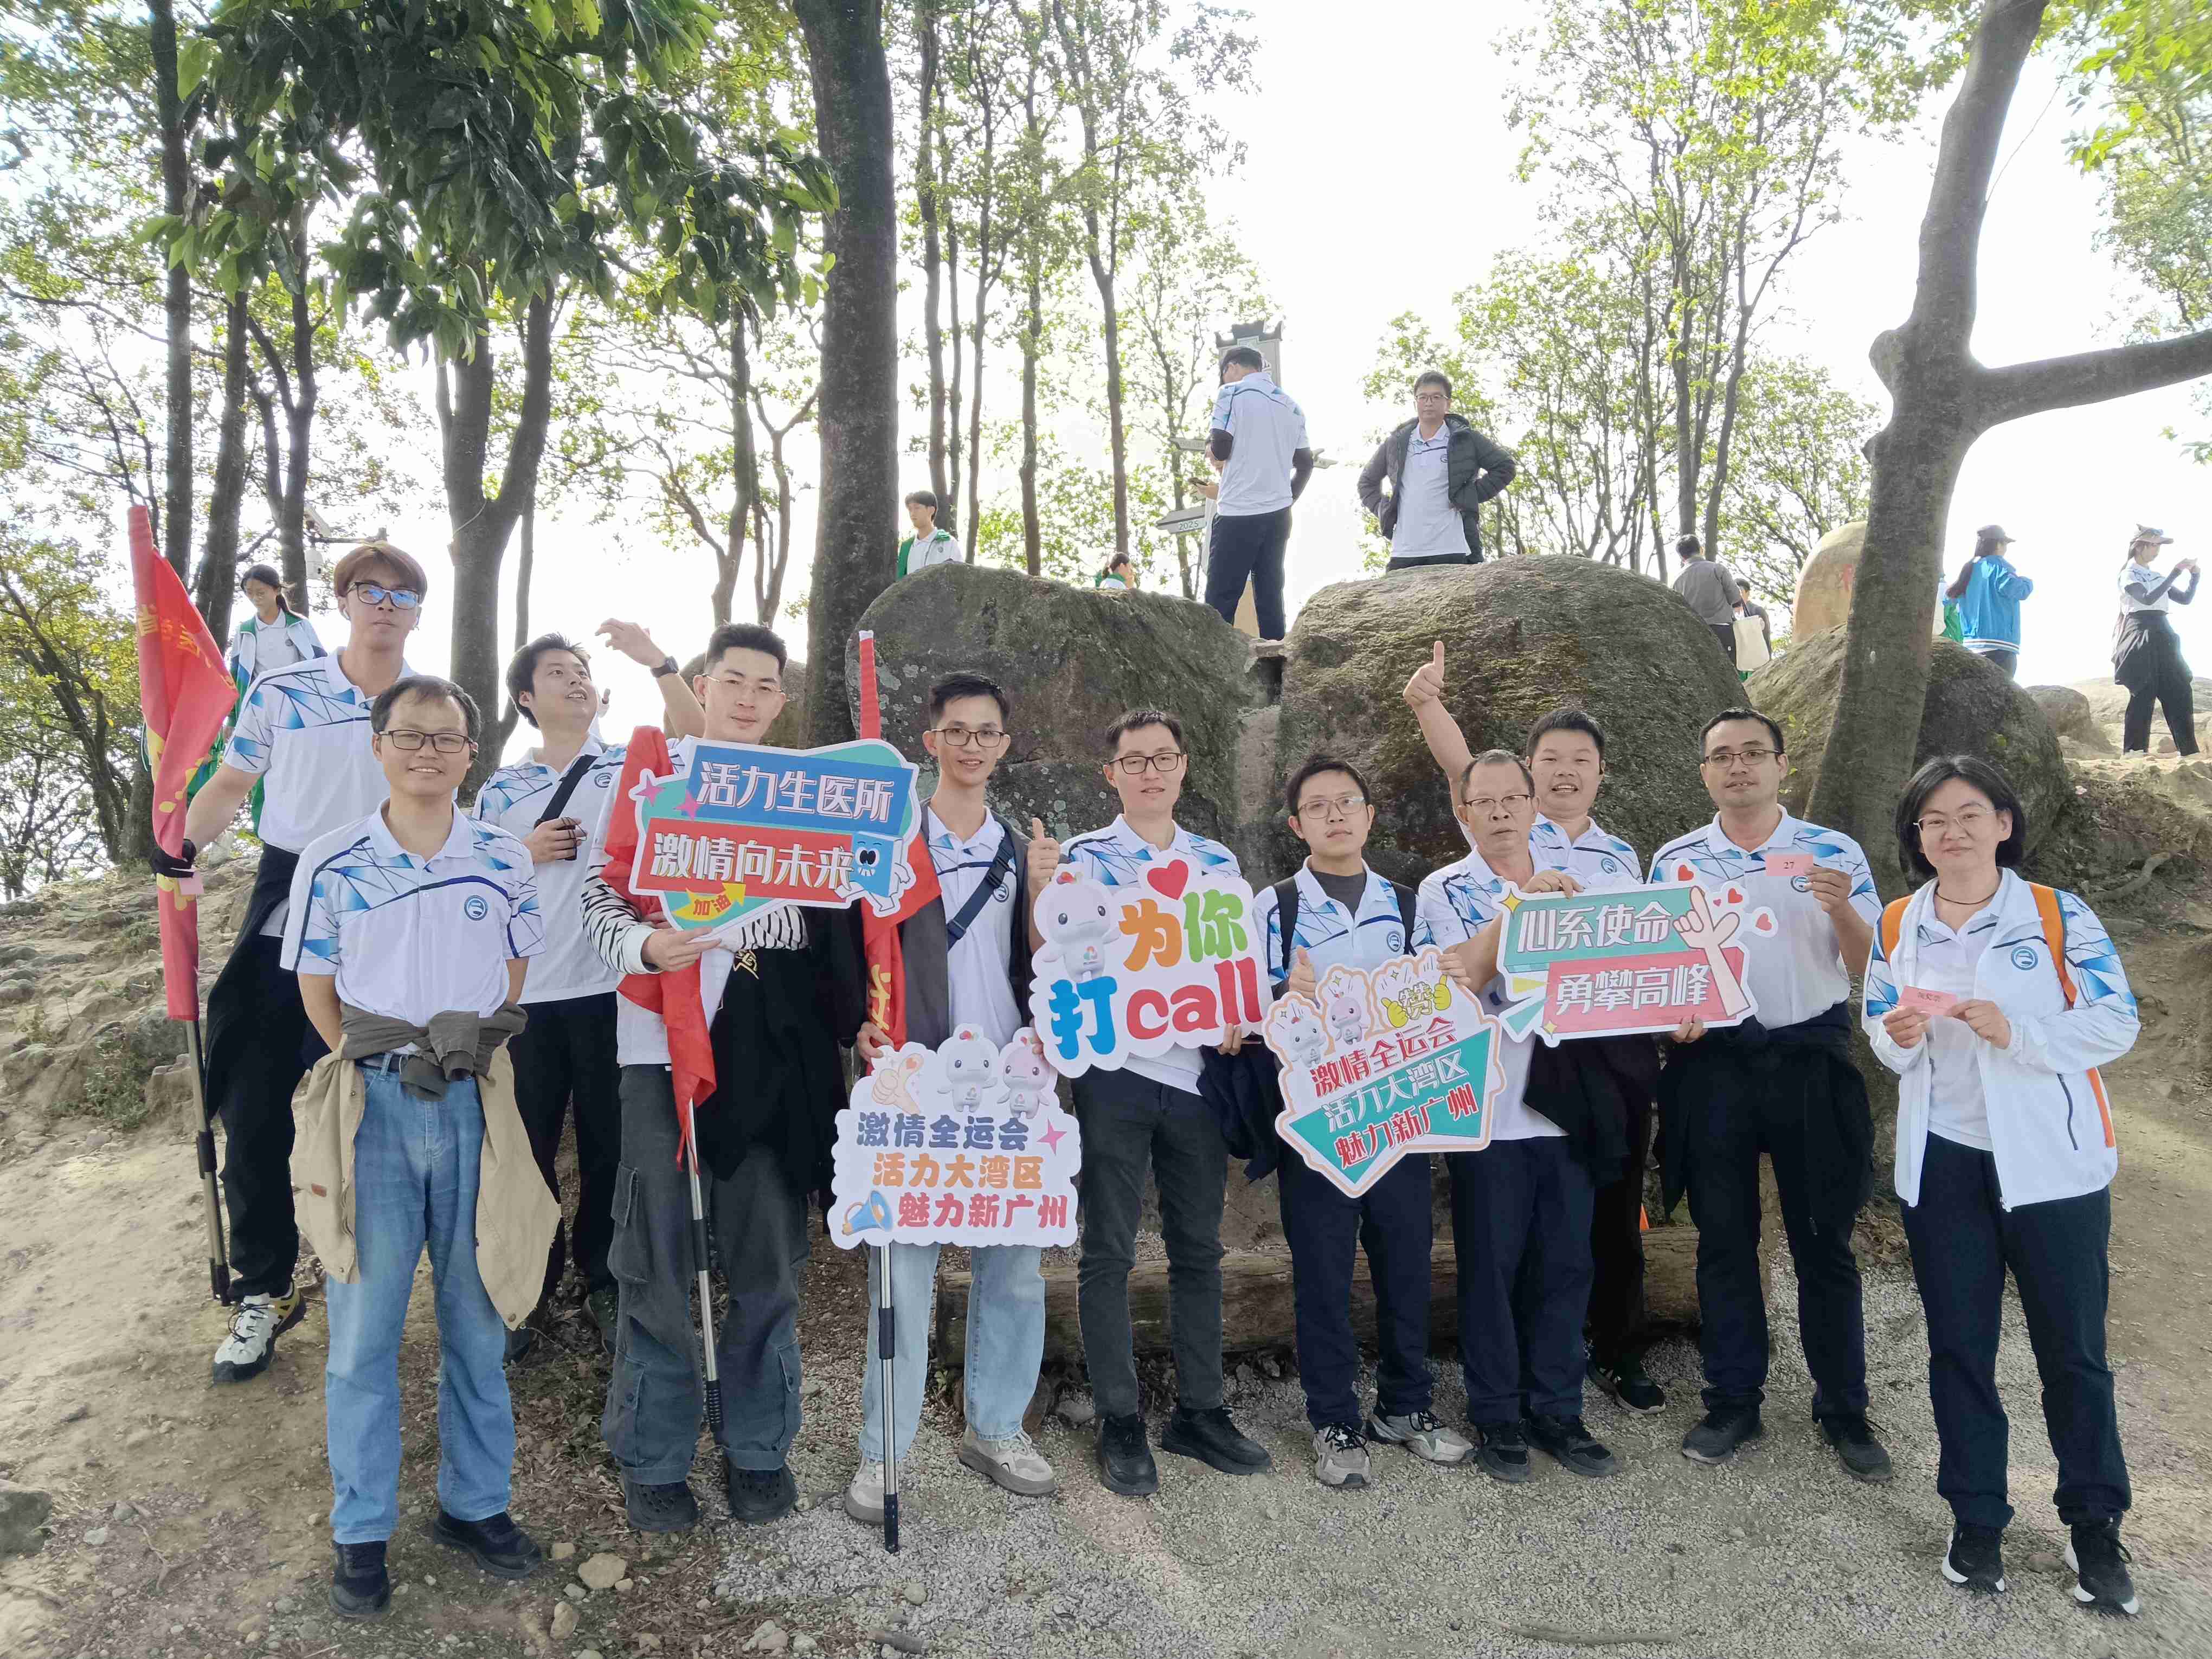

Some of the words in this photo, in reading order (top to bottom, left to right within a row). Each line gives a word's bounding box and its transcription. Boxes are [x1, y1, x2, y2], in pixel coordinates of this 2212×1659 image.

[696, 761, 895, 822] 活力生医所
[650, 832, 855, 892] 激情向未来
[1783, 861, 1795, 869] 27
[693, 895, 731, 916] 加油
[1118, 889, 1248, 972] 为你
[1517, 901, 1673, 953] 心系使命
[1556, 963, 1711, 1015] 勇攀高峰
[1310, 1017, 1457, 1098] 激情全运会
[1321, 1049, 1469, 1133] 活力大湾区
[857, 1112, 1029, 1150] 激情全运会
[1334, 1083, 1479, 1169] 魅力新广州
[872, 1152, 1044, 1189] 活力大湾区
[897, 1192, 1068, 1229] 魅力新广州
